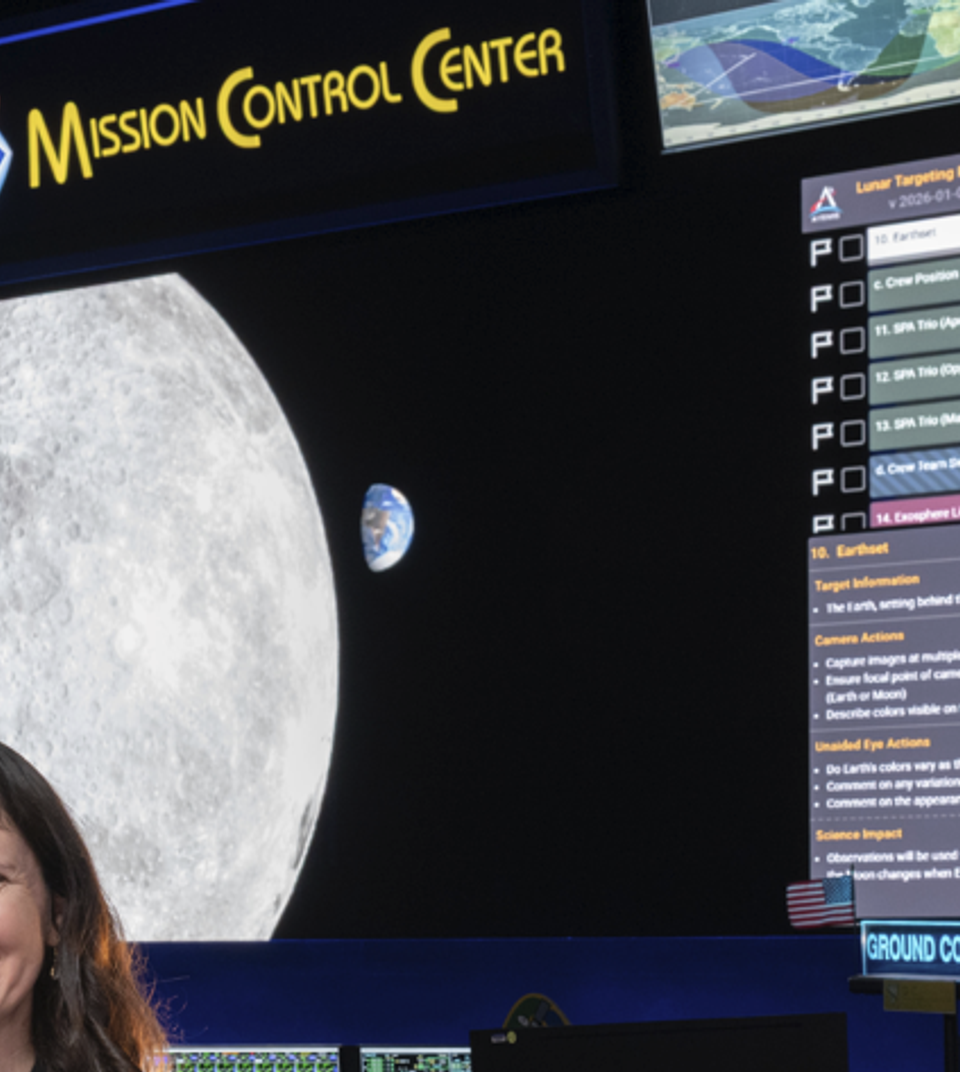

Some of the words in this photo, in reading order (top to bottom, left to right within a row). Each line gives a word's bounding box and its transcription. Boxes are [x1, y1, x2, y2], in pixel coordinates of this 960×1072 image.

[856, 178, 892, 194] Lunar
[894, 168, 955, 187] Targeting
[892, 228, 937, 243] Earthset
[885, 276, 914, 289] Crew
[914, 269, 959, 285] Position
[874, 325, 891, 337] 11.
[893, 320, 916, 334] SPA
[917, 318, 939, 331] Trio
[874, 371, 891, 383] 12.
[893, 367, 916, 381] SPA
[917, 365, 939, 378] Trio
[875, 420, 891, 432] 13.
[894, 415, 916, 429] SPA
[918, 413, 939, 427] Trio
[887, 462, 916, 475] Crew
[918, 459, 948, 472] Team
[876, 510, 893, 523] 14.
[894, 507, 950, 523] Exosphere
[810, 546, 830, 559] 10.
[836, 542, 889, 558] Earthset
[814, 579, 851, 593] Target
[852, 574, 921, 590] Information
[826, 602, 845, 614] The
[878, 597, 916, 611] setting
[917, 594, 953, 607] behind
[814, 634, 859, 647] Camera
[860, 631, 905, 644] Actions
[825, 656, 866, 670] Capture
[867, 653, 907, 667] images
[907, 652, 920, 664] at
[825, 674, 861, 686] Ensure
[862, 671, 890, 684] focal
[891, 669, 919, 684] point
[919, 668, 933, 680] of
[825, 690, 858, 704] (Earth
[858, 691, 871, 701] or
[871, 687, 907, 701] Moon)
[825, 707, 871, 720] Describe
[872, 704, 905, 717] colors
[907, 702, 941, 716] visible
[943, 703, 958, 714] on
[815, 739, 862, 752] Unaided
[863, 737, 885, 752] Eye
[886, 736, 932, 749] Actions
[826, 763, 841, 775] Do
[878, 760, 912, 772] colors
[913, 761, 937, 773] vary
[937, 760, 952, 770] as
[826, 779, 878, 792] Comment
[878, 780, 893, 791] on
[894, 779, 914, 792] any
[826, 797, 878, 809] Comment
[878, 797, 893, 807] on
[894, 795, 912, 806] the
[815, 828, 861, 842] Science
[862, 827, 903, 842] Impact
[826, 852, 894, 864] Observations
[896, 850, 915, 862] will
[916, 850, 930, 861] be
[931, 849, 959, 861] used
[876, 868, 922, 883] changes
[923, 866, 952, 879] when
[867, 933, 936, 963] GROUND
